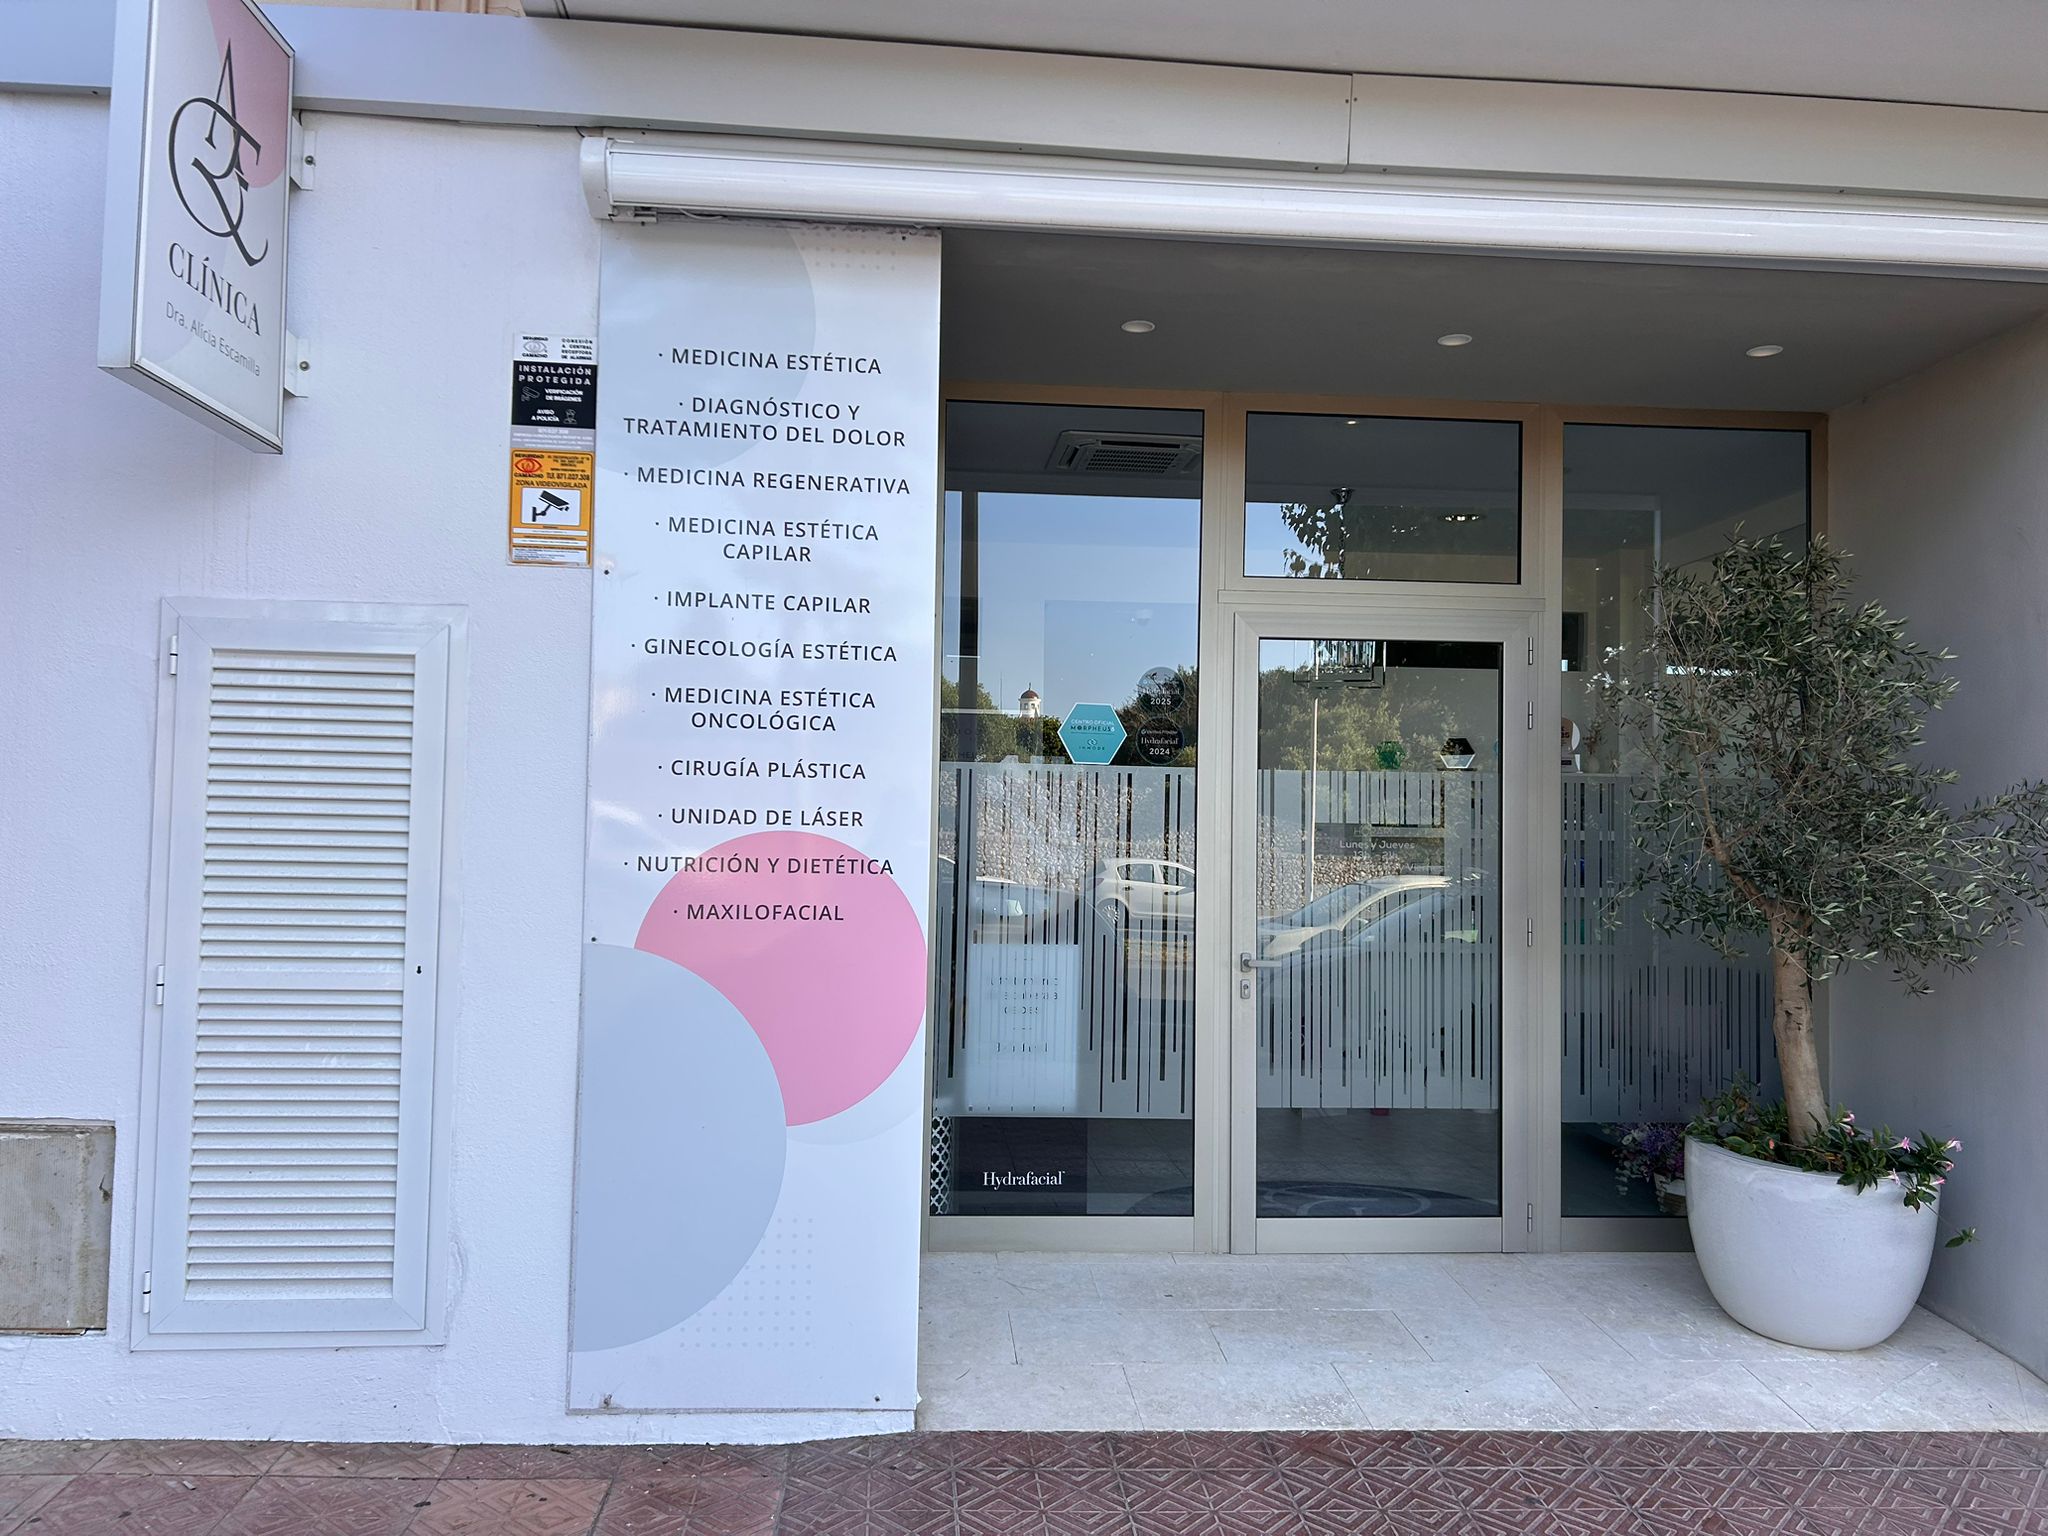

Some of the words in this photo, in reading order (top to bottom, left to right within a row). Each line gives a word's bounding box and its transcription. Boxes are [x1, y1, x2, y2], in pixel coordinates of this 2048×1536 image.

[169, 242, 261, 336] CLÍNICA
[166, 302, 188, 331] Dra.
[190, 317, 217, 349] Alicia
[218, 336, 261, 377] Escamilla
[518, 364, 592, 376] INSTALACIÓN
[673, 349, 778, 368] MEDICINA
[787, 353, 881, 374] ESTÉTICA
[518, 374, 591, 386] PROTEGIDA
[544, 388, 583, 396] VERIFICACIÓN
[693, 397, 839, 419] DIAGNÓSTICO
[848, 405, 859, 420] Y
[624, 418, 777, 440] TRATAMIENTO
[787, 427, 824, 442] DEL
[833, 429, 904, 446] DOLOR
[536, 481, 588, 489] VIDEOVIGILADA
[638, 467, 744, 486] MEDICINA
[754, 473, 909, 494] REGENERATIVA
[669, 517, 775, 536] MEDICINA
[785, 520, 878, 540] ESTÉTICA
[724, 544, 810, 562] CAPILAR
[668, 591, 774, 610] IMPLANTE
[784, 596, 870, 613] CAPILAR
[645, 639, 794, 658] GINECOLOGÍA
[803, 641, 896, 661] ESTÉTICA
[666, 688, 772, 705] MEDICINA
[781, 688, 875, 708] ESTÉTICA
[692, 711, 835, 731] ONCOLÓGICA
[1149, 747, 1170, 755] 2024
[672, 758, 759, 776] CIRUGÍA
[769, 759, 865, 779] PLÁSTICA
[672, 809, 756, 824] UNIDAD
[767, 810, 791, 825] DE
[802, 807, 862, 826] LÁSER
[1340, 840, 1370, 849] Lunes
[1371, 842, 1377, 851] y
[1379, 840, 1415, 849] Jueves
[638, 853, 758, 873] NUTRICIÓN
[768, 858, 779, 873] Y
[788, 855, 893, 874] DIETÉTICA
[688, 905, 843, 920] MAXILOFACIAL
[983, 1171, 1063, 1191] Hydrafacial
